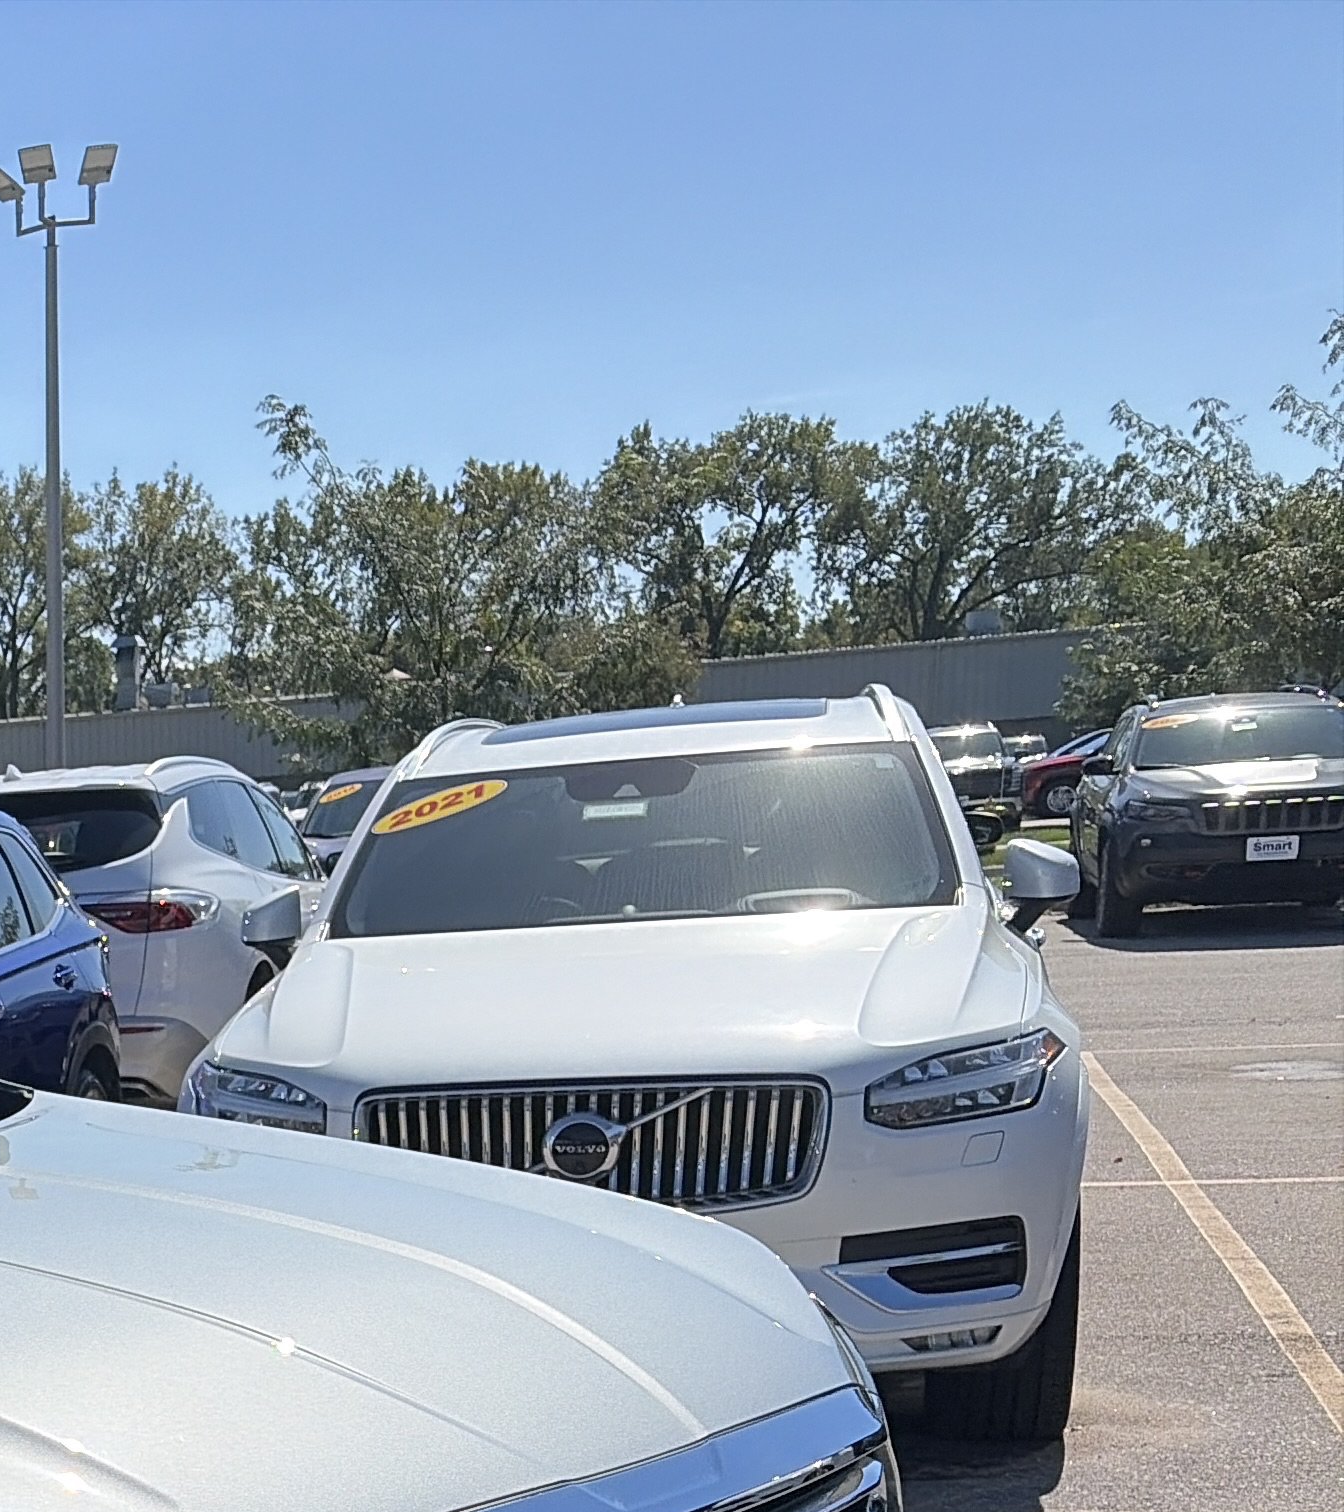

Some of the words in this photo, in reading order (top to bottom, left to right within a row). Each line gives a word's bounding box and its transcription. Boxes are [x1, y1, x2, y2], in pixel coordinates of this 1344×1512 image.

[388, 784, 486, 830] 2021
[1253, 841, 1292, 852] Smart
[555, 1144, 606, 1154] VOLVO
